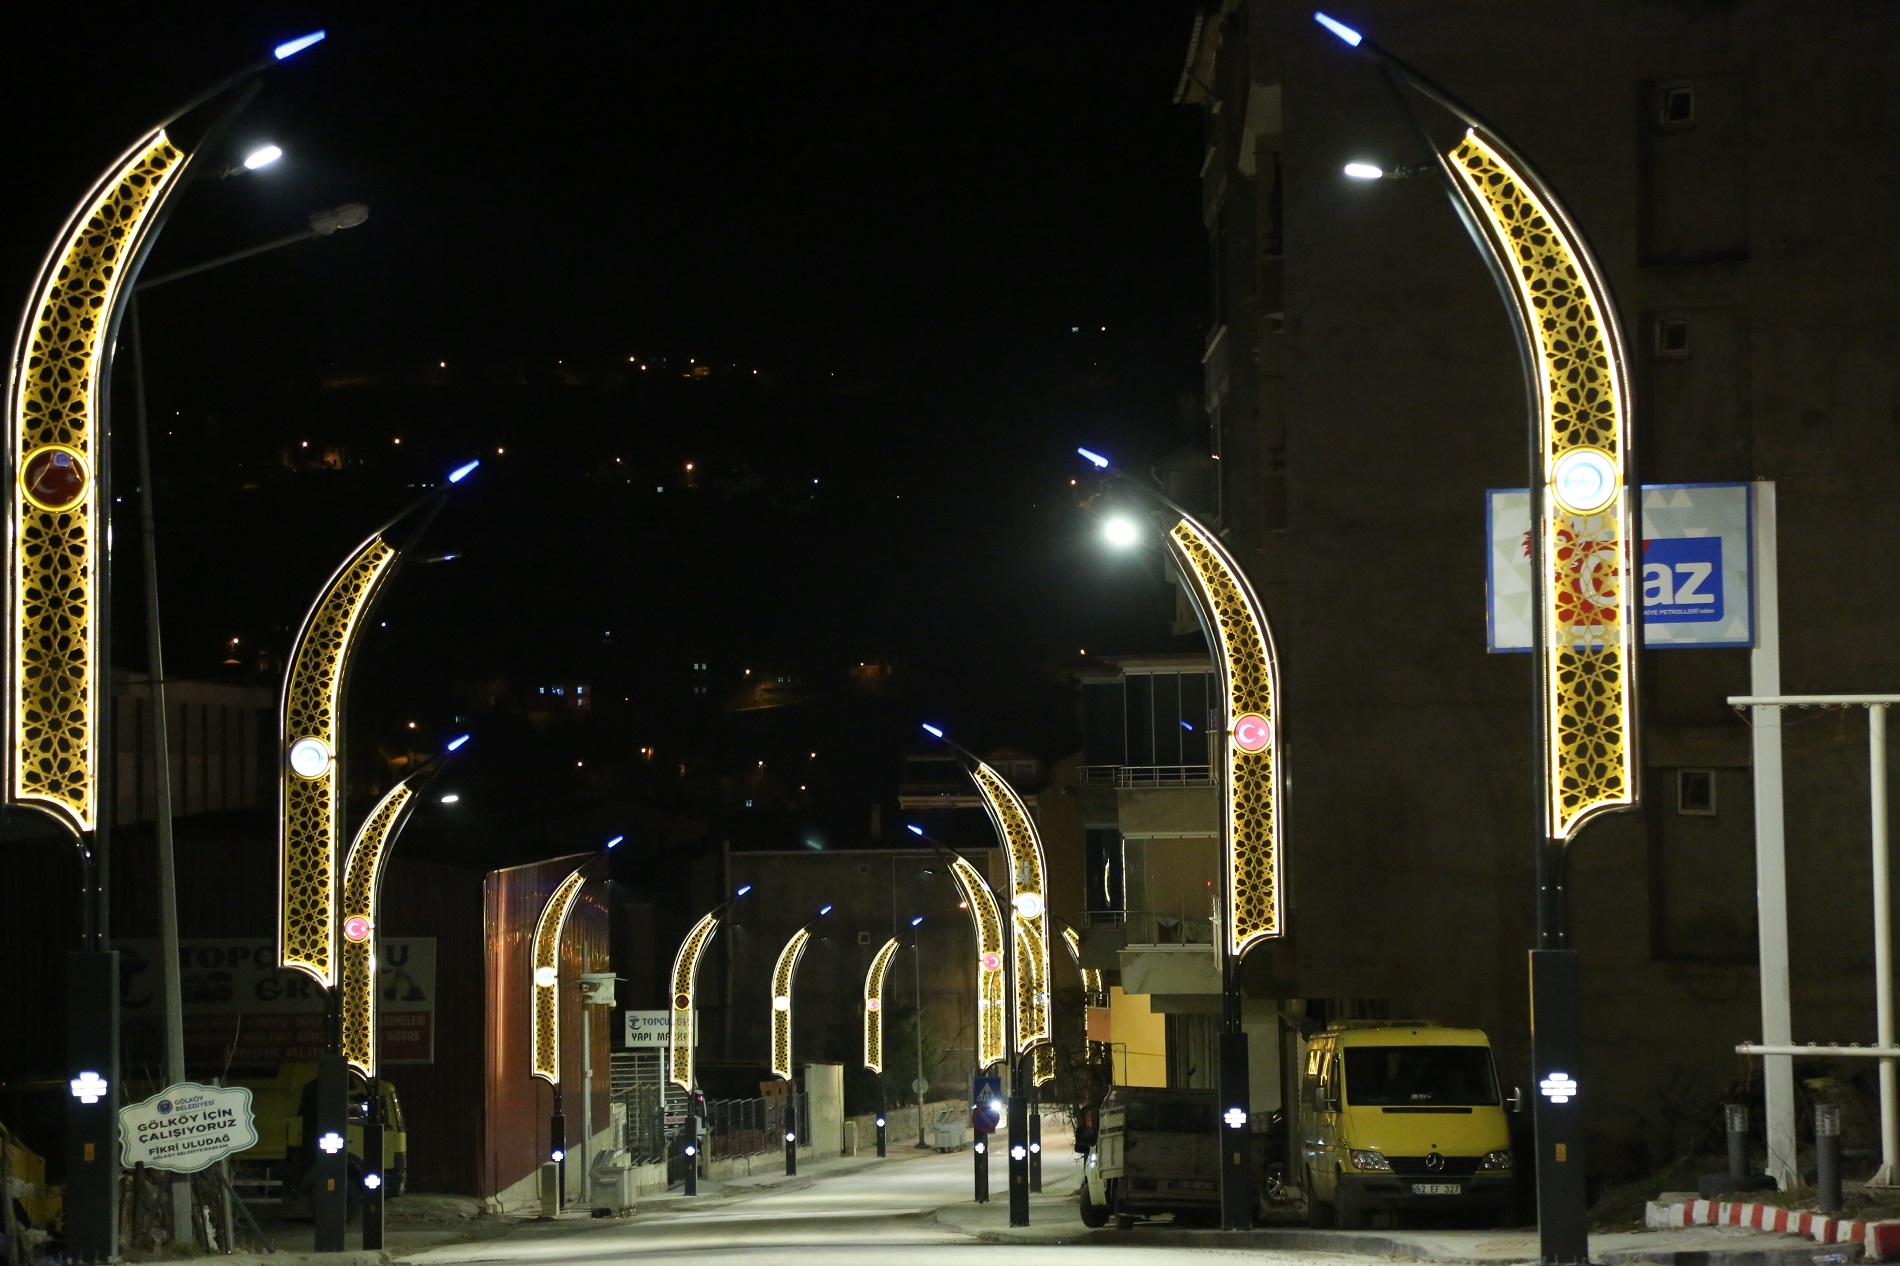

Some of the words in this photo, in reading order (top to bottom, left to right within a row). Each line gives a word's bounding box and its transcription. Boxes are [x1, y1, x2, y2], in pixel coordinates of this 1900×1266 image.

[632, 1032, 652, 1041] YAPI
[174, 1095, 204, 1105] GÖLKÖY
[175, 1099, 215, 1112] BELEDİYESİ
[137, 1114, 199, 1132] GÖLKÖY
[203, 1108, 233, 1121] İÇİN
[139, 1118, 237, 1144] ÇALIŞIYORUZ
[149, 1142, 179, 1156] FİKRİ
[182, 1133, 231, 1149] ULUDAĞ
[1430, 1185, 1440, 1193] EF
[1445, 1185, 1459, 1193] 327
